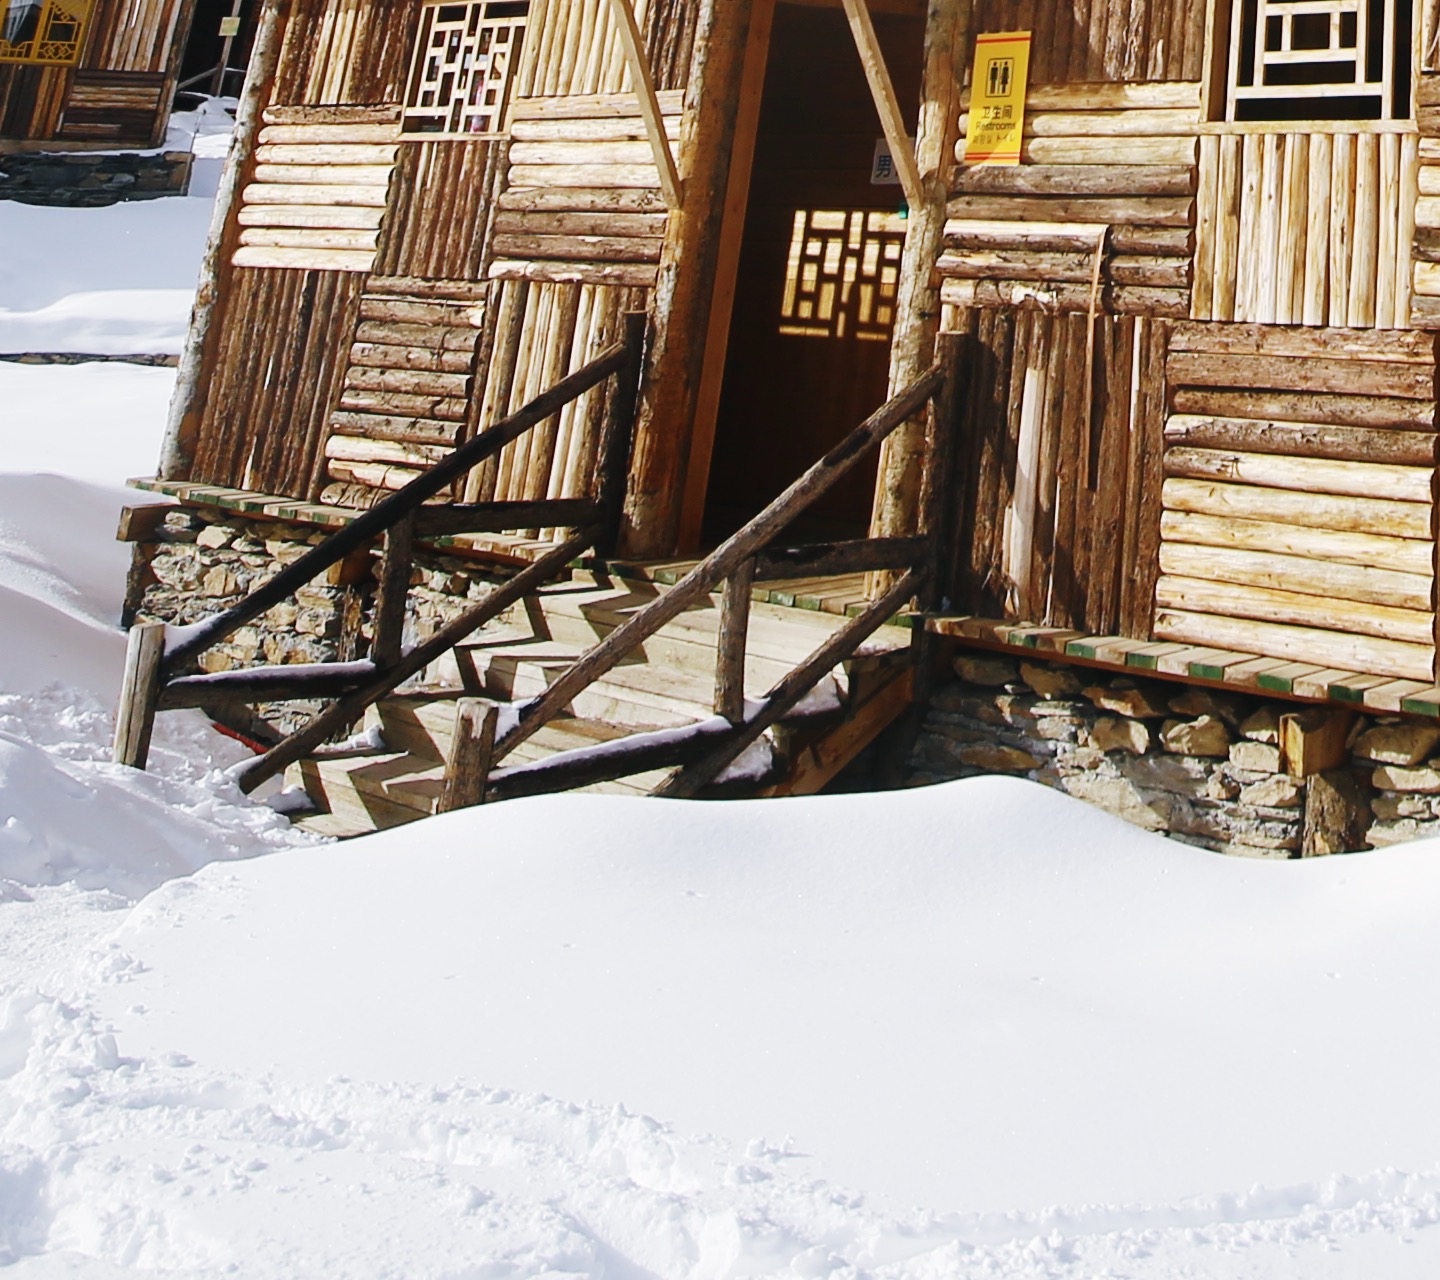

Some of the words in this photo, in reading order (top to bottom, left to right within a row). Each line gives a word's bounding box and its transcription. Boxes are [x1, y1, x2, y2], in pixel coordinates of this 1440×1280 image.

[980, 104, 1013, 120] 卫生间
[875, 154, 892, 178] 男
